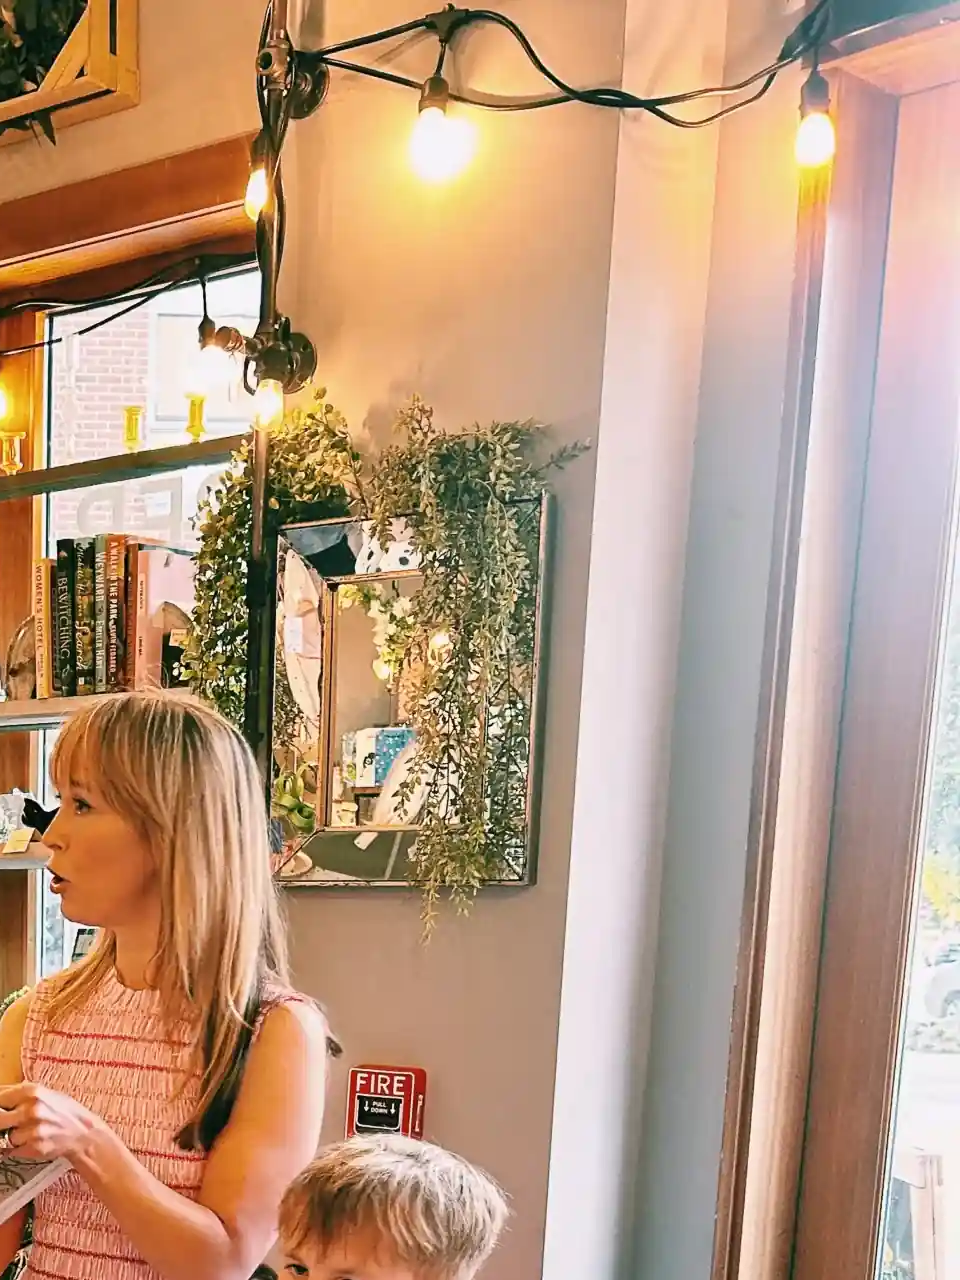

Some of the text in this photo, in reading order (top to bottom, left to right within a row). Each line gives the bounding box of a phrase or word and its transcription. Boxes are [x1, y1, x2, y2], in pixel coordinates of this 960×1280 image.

[35, 565, 43, 613] WOMEN'S
[95, 552, 106, 602] WEYWARD
[109, 582, 118, 597] THE
[57, 577, 71, 659] BEWITCHING
[109, 599, 118, 619] PARK
[75, 620, 91, 671] Search
[356, 1073, 406, 1096] FIRE
[372, 1100, 387, 1108] PULL
